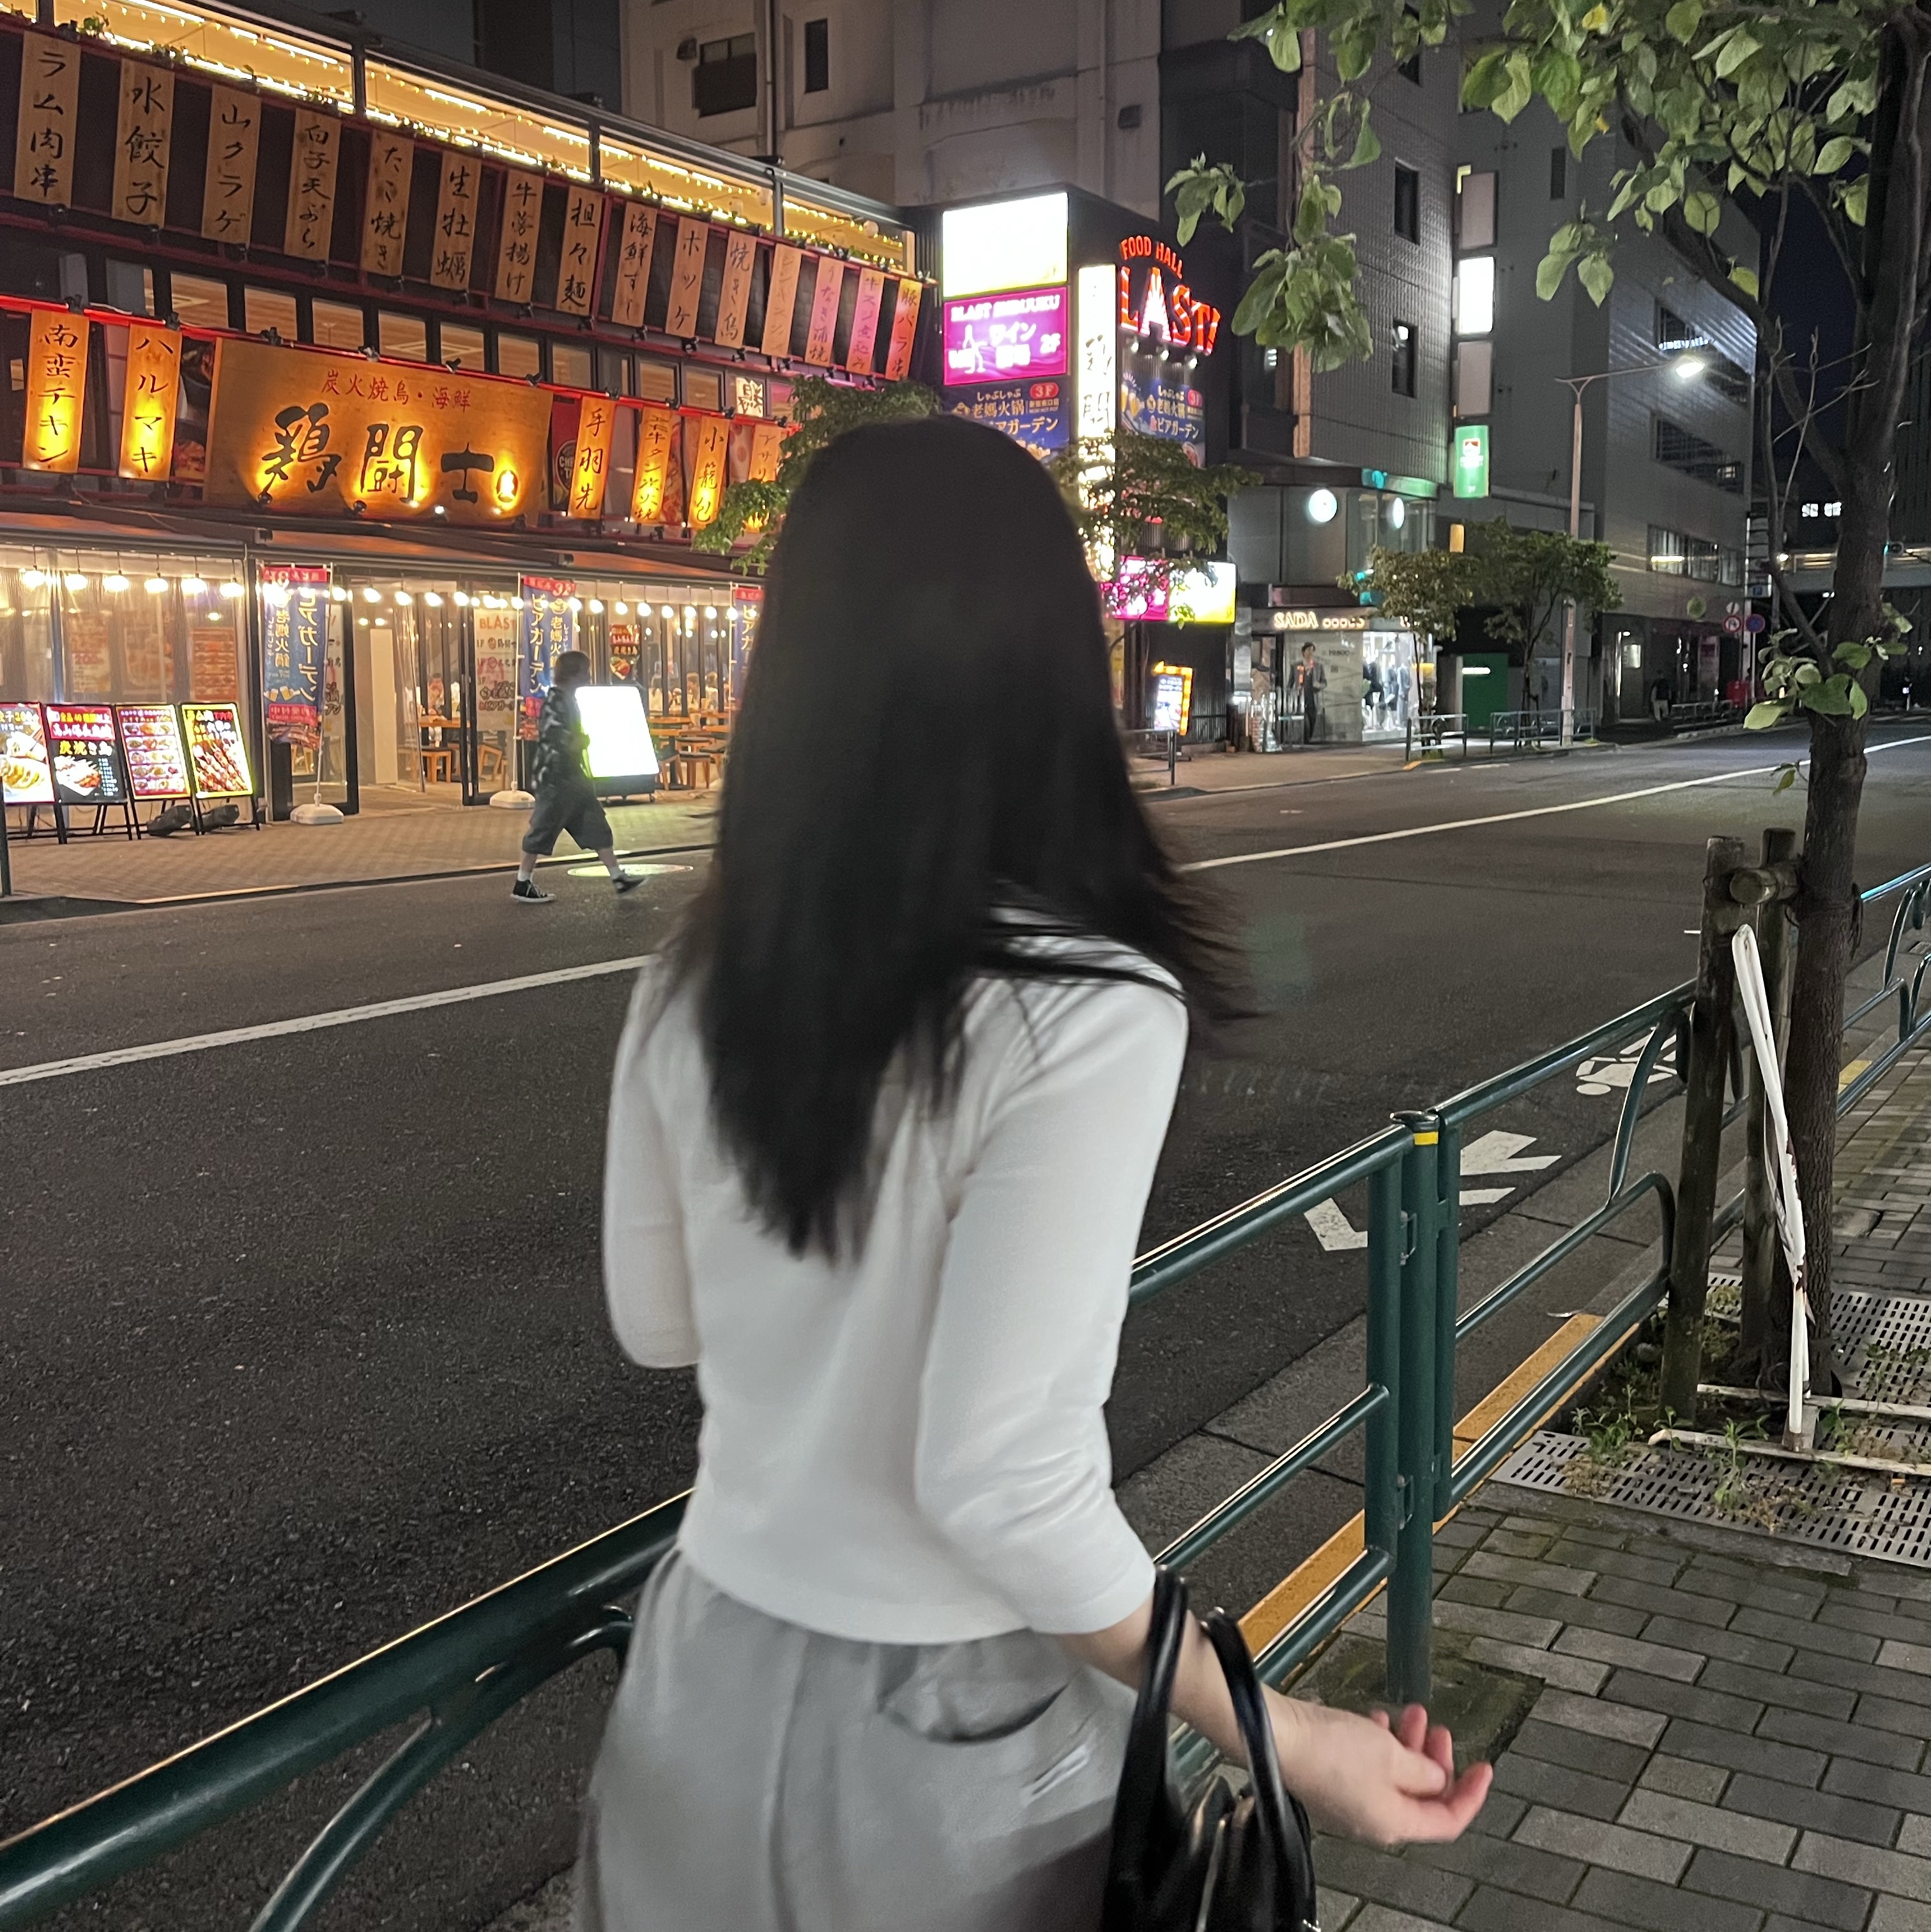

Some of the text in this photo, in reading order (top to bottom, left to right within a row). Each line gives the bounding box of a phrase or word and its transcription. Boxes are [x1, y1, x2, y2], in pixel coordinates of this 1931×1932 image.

[125, 77, 165, 215] 水餃子
[215, 105, 251, 232] 山クラゲ
[675, 231, 700, 330] ホッケ
[1121, 236, 1182, 279] FOOD HALL
[132, 338, 174, 473] ハルマキ
[991, 416, 1059, 435] アガーデン
[1035, 384, 1054, 397] 3F
[576, 407, 606, 510] 手羽先
[480, 615, 516, 630] BLAST
[1274, 611, 1319, 629] SADA
